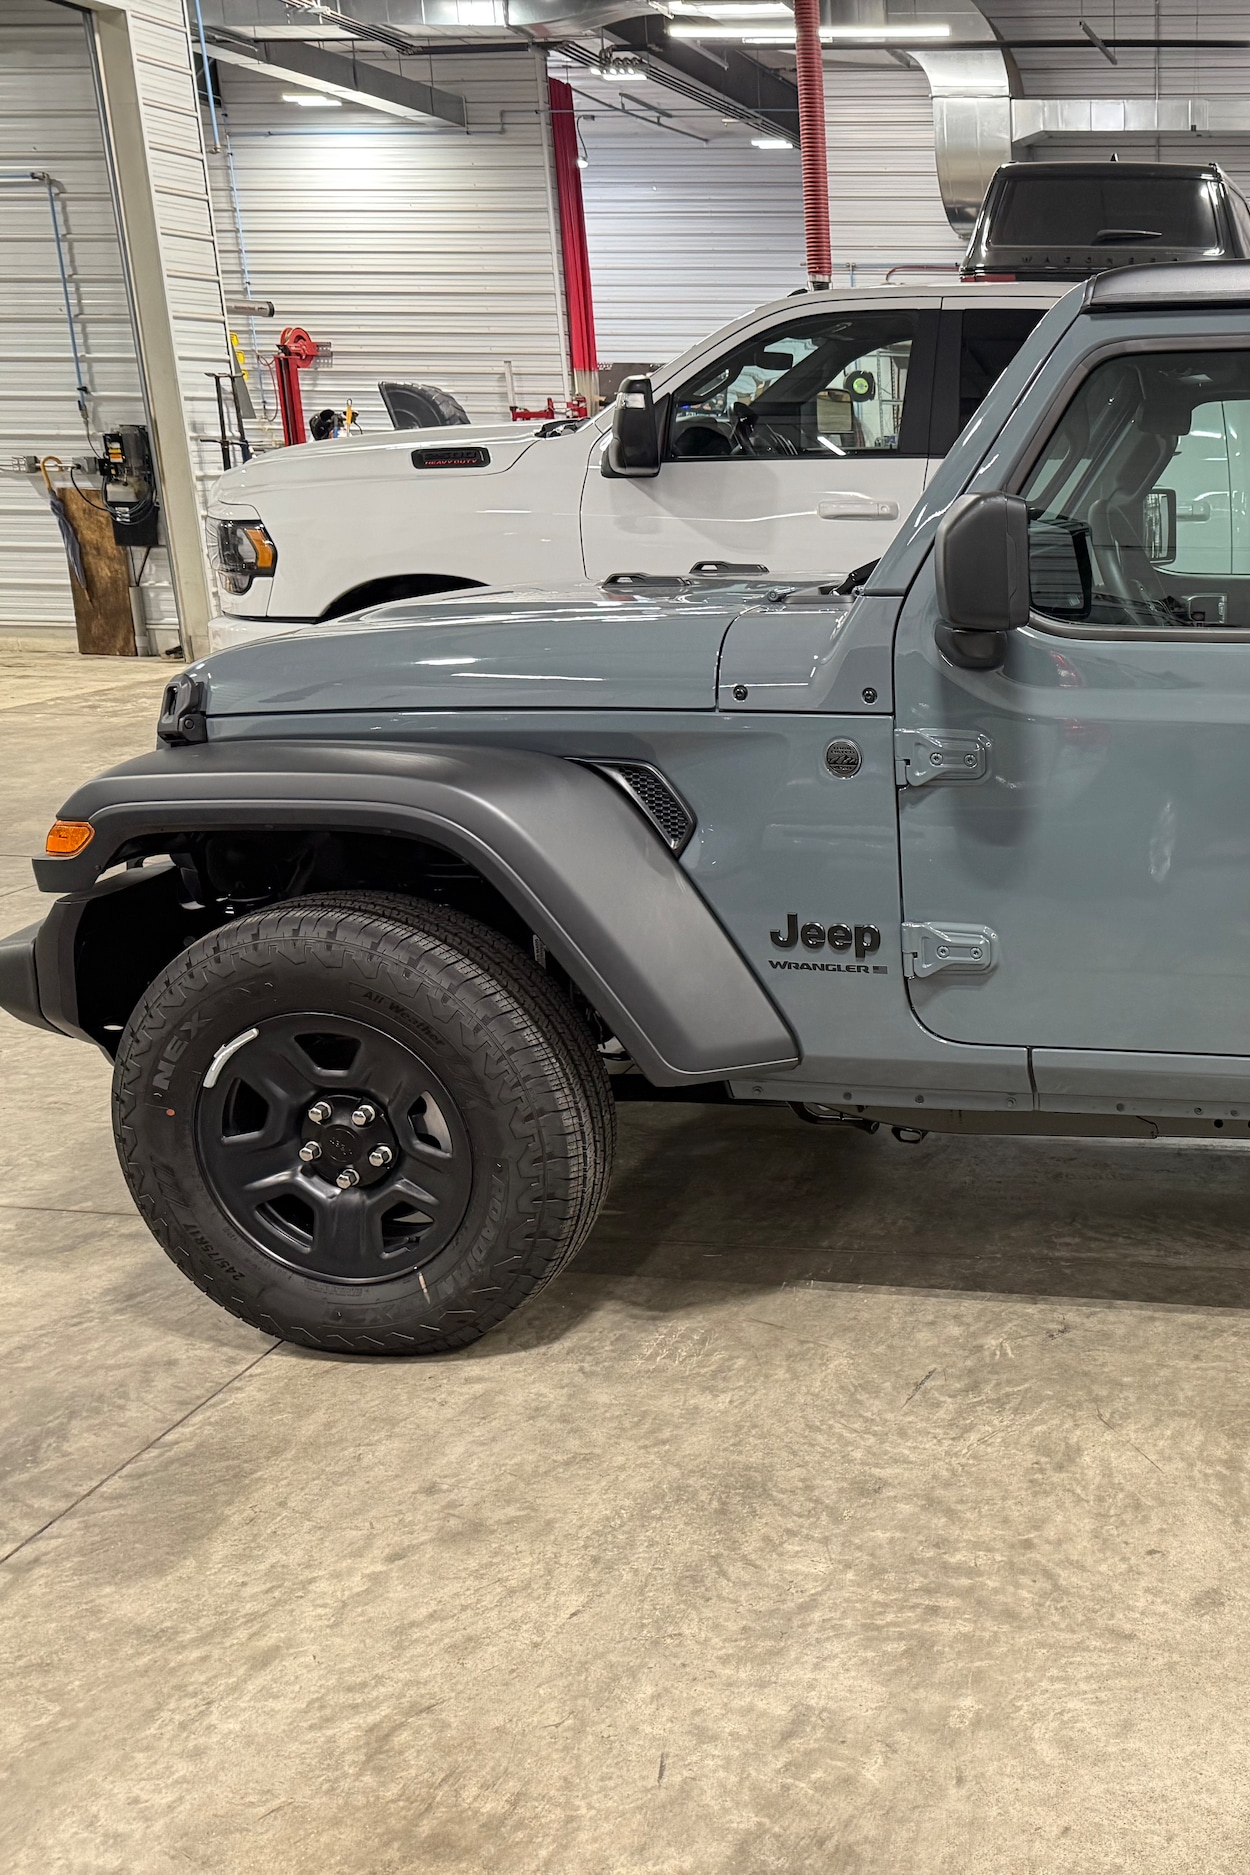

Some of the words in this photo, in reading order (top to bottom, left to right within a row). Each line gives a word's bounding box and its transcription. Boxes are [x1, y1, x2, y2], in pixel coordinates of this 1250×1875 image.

[770, 911, 881, 959] Jeep
[768, 960, 870, 974] WRANGLER
[183, 1223, 246, 1281] 245/75R17
